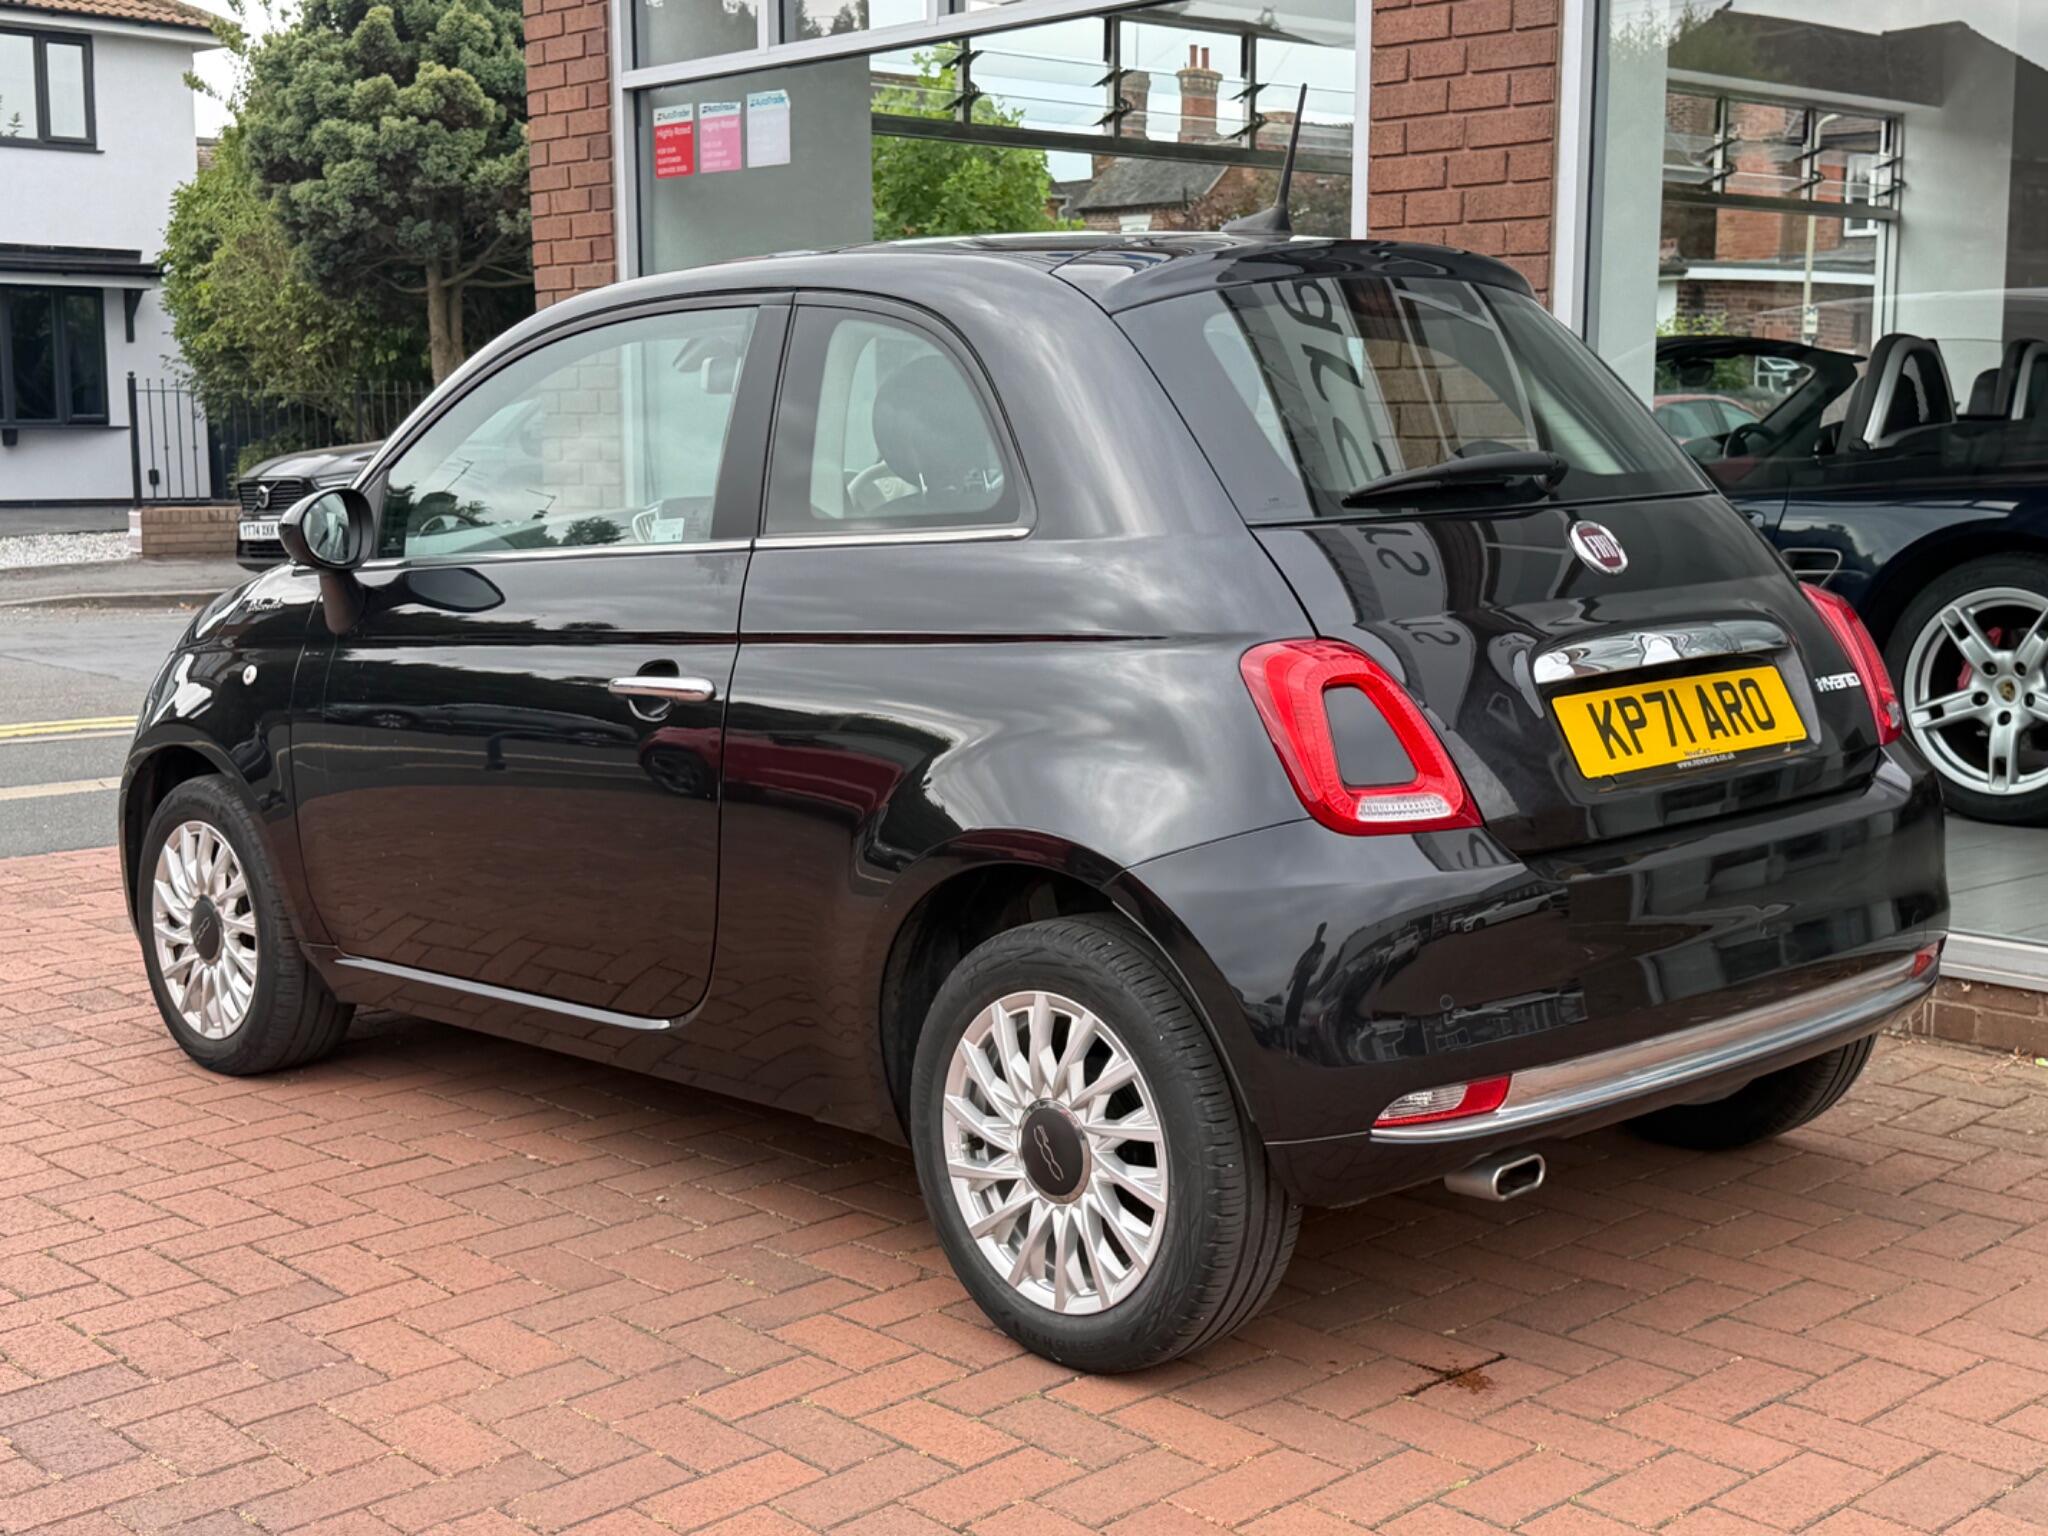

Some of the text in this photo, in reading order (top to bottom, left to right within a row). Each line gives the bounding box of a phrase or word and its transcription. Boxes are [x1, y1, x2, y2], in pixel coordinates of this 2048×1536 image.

[1583, 534, 1619, 559] FIAT
[1586, 678, 1776, 759] KP71 ARO
